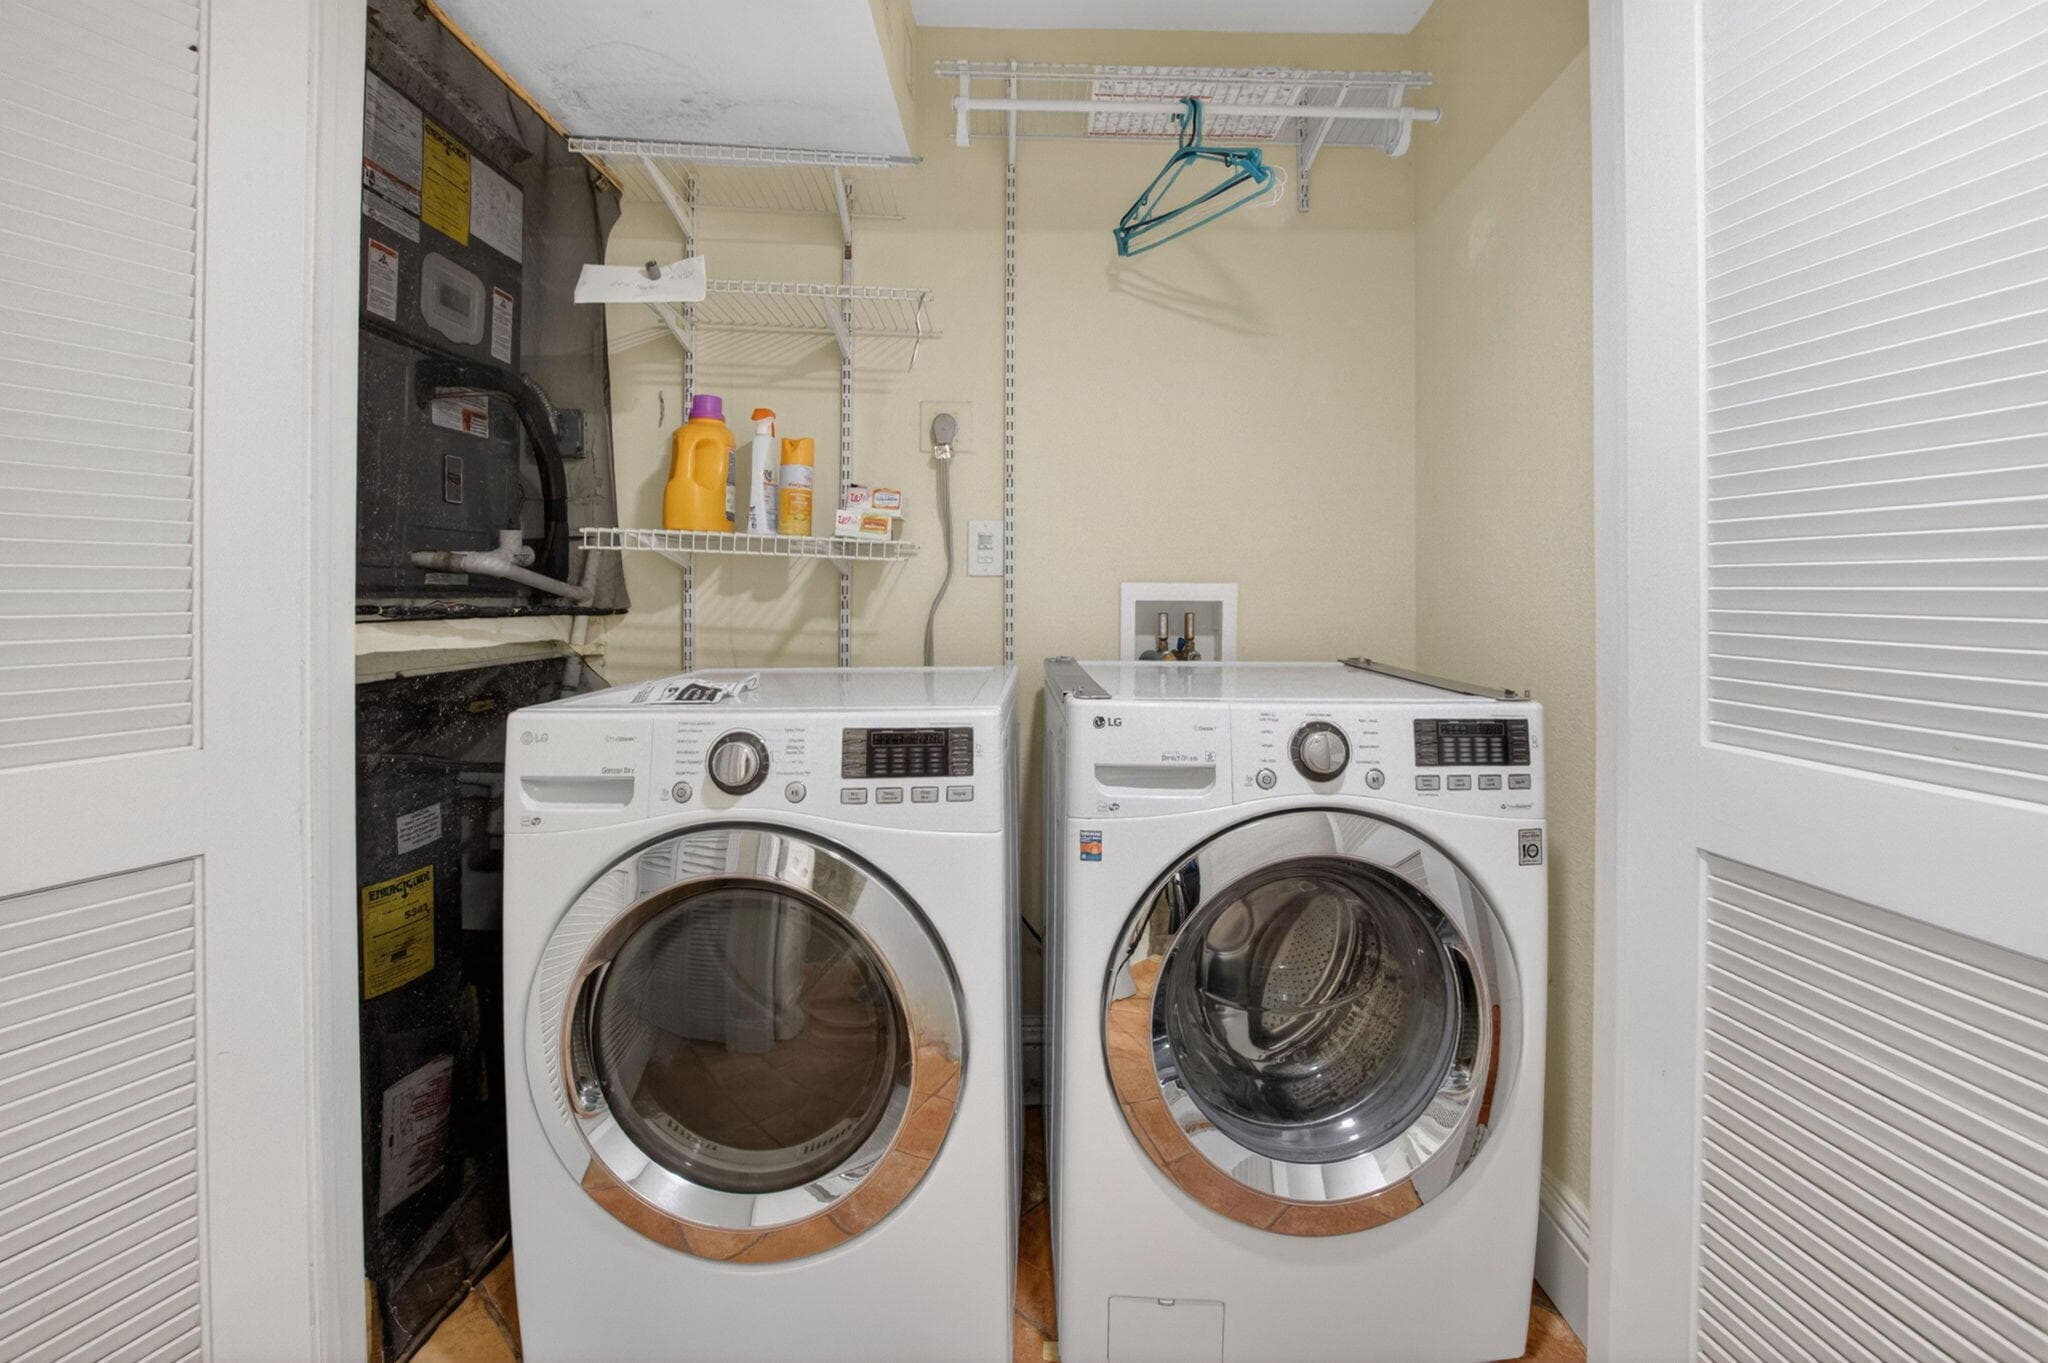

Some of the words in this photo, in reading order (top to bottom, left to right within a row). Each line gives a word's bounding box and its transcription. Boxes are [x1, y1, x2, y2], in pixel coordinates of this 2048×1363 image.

[1107, 718, 1122, 727] LG
[534, 733, 549, 743] LG
[1522, 843, 1539, 858] 10
